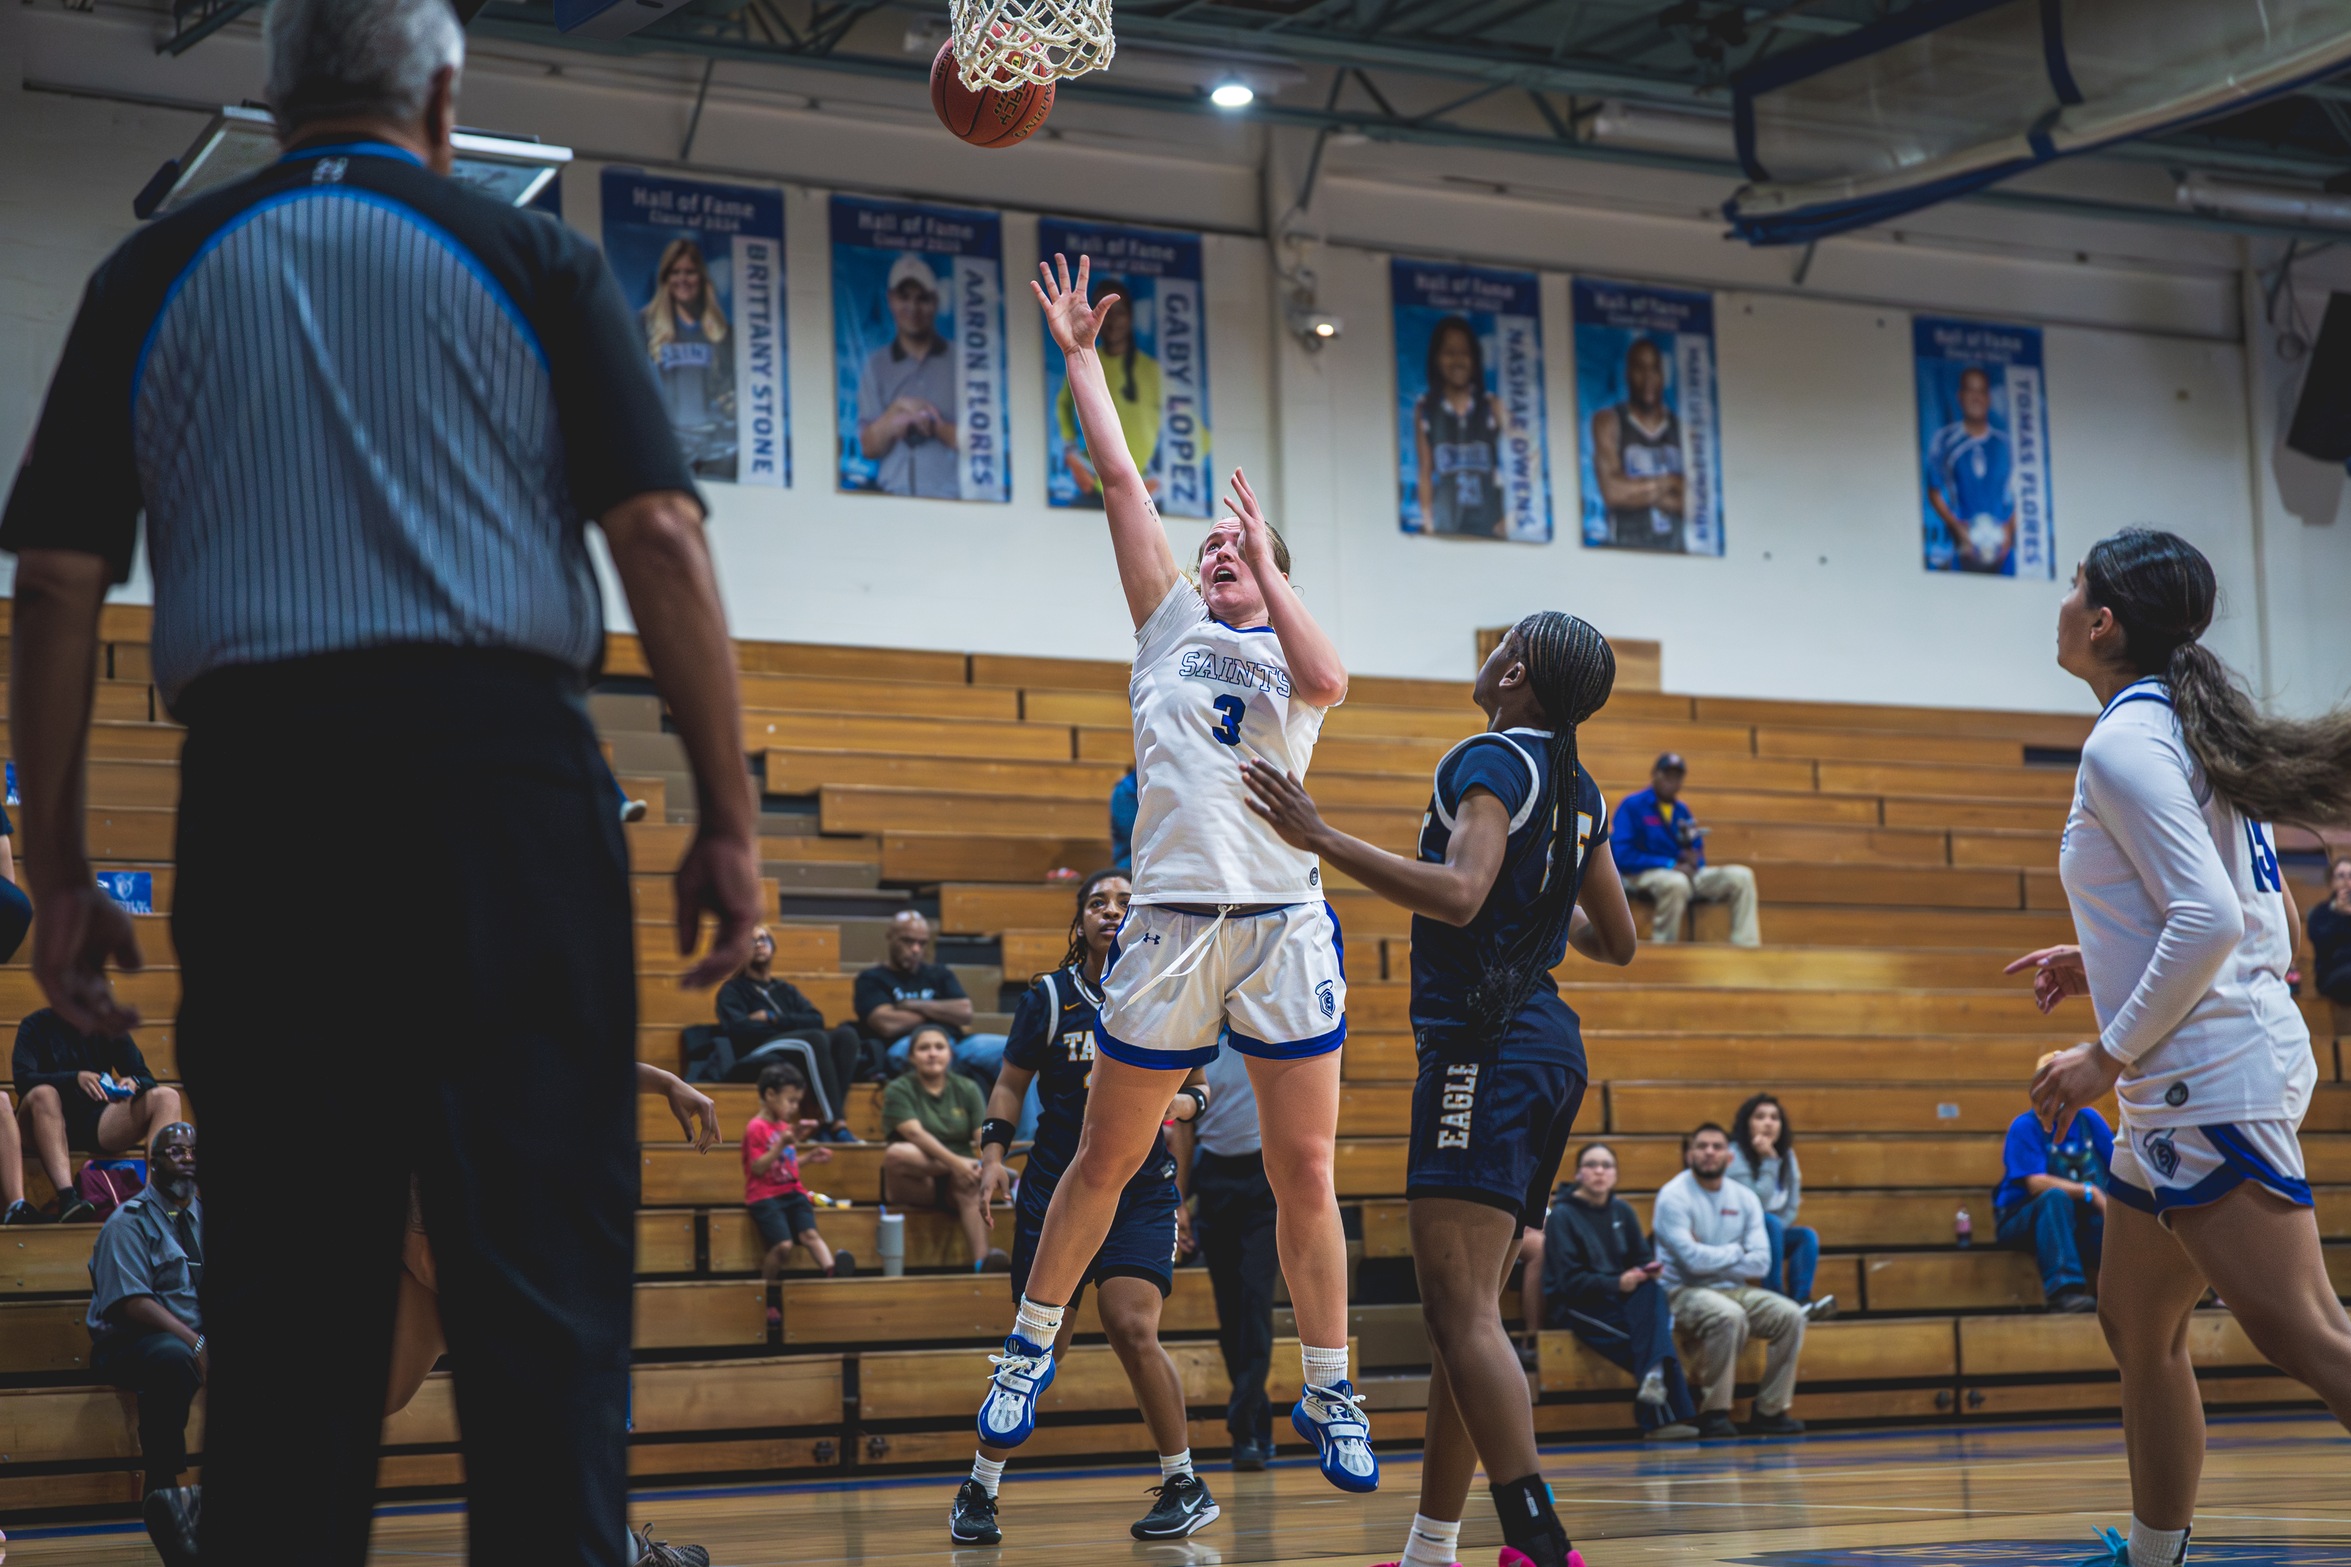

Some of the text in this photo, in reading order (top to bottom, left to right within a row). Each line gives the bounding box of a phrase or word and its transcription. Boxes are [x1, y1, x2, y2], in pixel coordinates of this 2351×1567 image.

[632, 186, 755, 220] Hall of Fame
[859, 209, 974, 241] Hall of Fame
[1066, 233, 1176, 262] Hall of Fame
[746, 245, 774, 474] BRITTANY STONE
[965, 269, 994, 487] AARON FLORES
[1165, 292, 1197, 500] GABY LOPEZ
[1510, 438, 1536, 529] OWENS
[2015, 379, 2043, 566] TOMAS FLORES
[1179, 651, 1292, 698] SAINTS
[1211, 693, 1246, 747] 3
[1437, 1063, 1479, 1149] EAGLE
